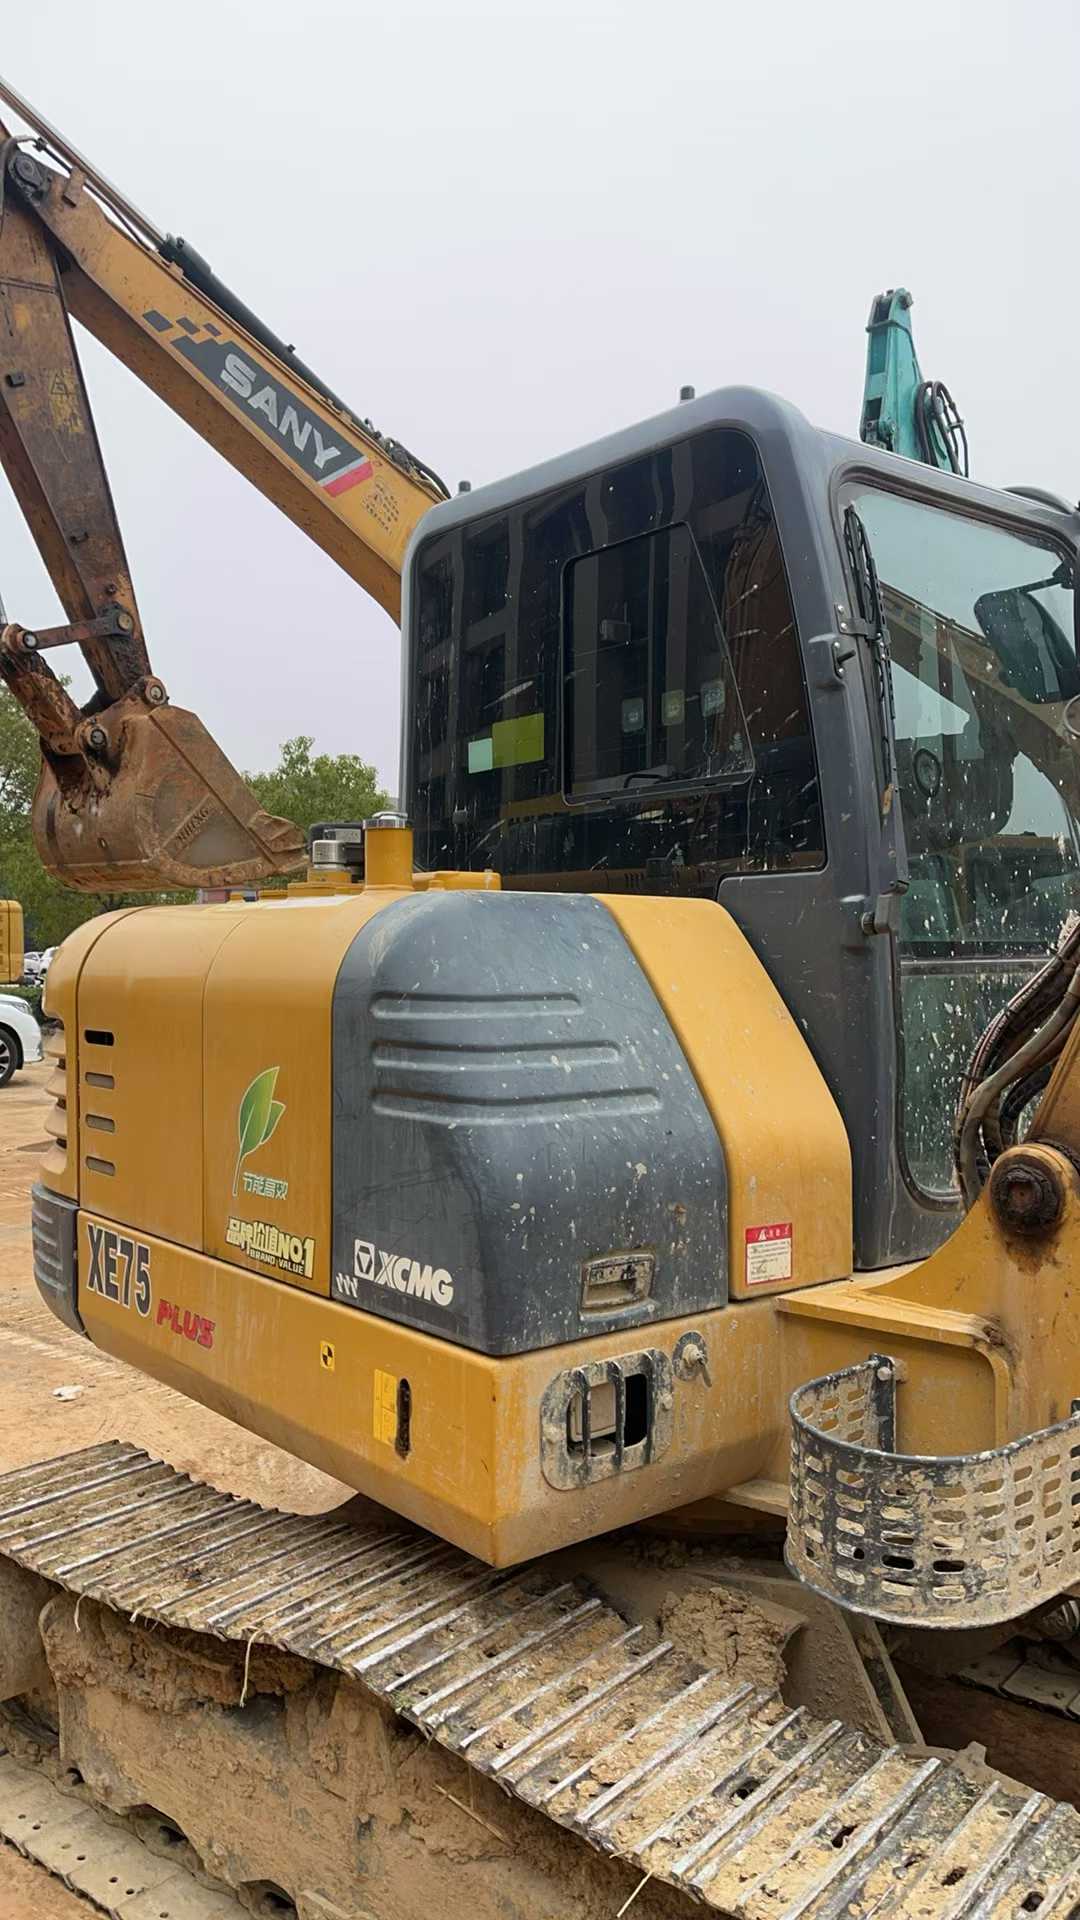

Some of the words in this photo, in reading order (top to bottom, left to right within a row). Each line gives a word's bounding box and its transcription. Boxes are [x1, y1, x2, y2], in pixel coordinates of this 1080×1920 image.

[220, 353, 341, 469] SANY
[242, 1171, 289, 1201] 节能高效
[86, 1222, 152, 1317] XE75
[249, 1248, 276, 1266] BRAND
[278, 1258, 304, 1275] VALUE
[374, 1249, 454, 1306] XCMG
[156, 1298, 216, 1349] PLUS
